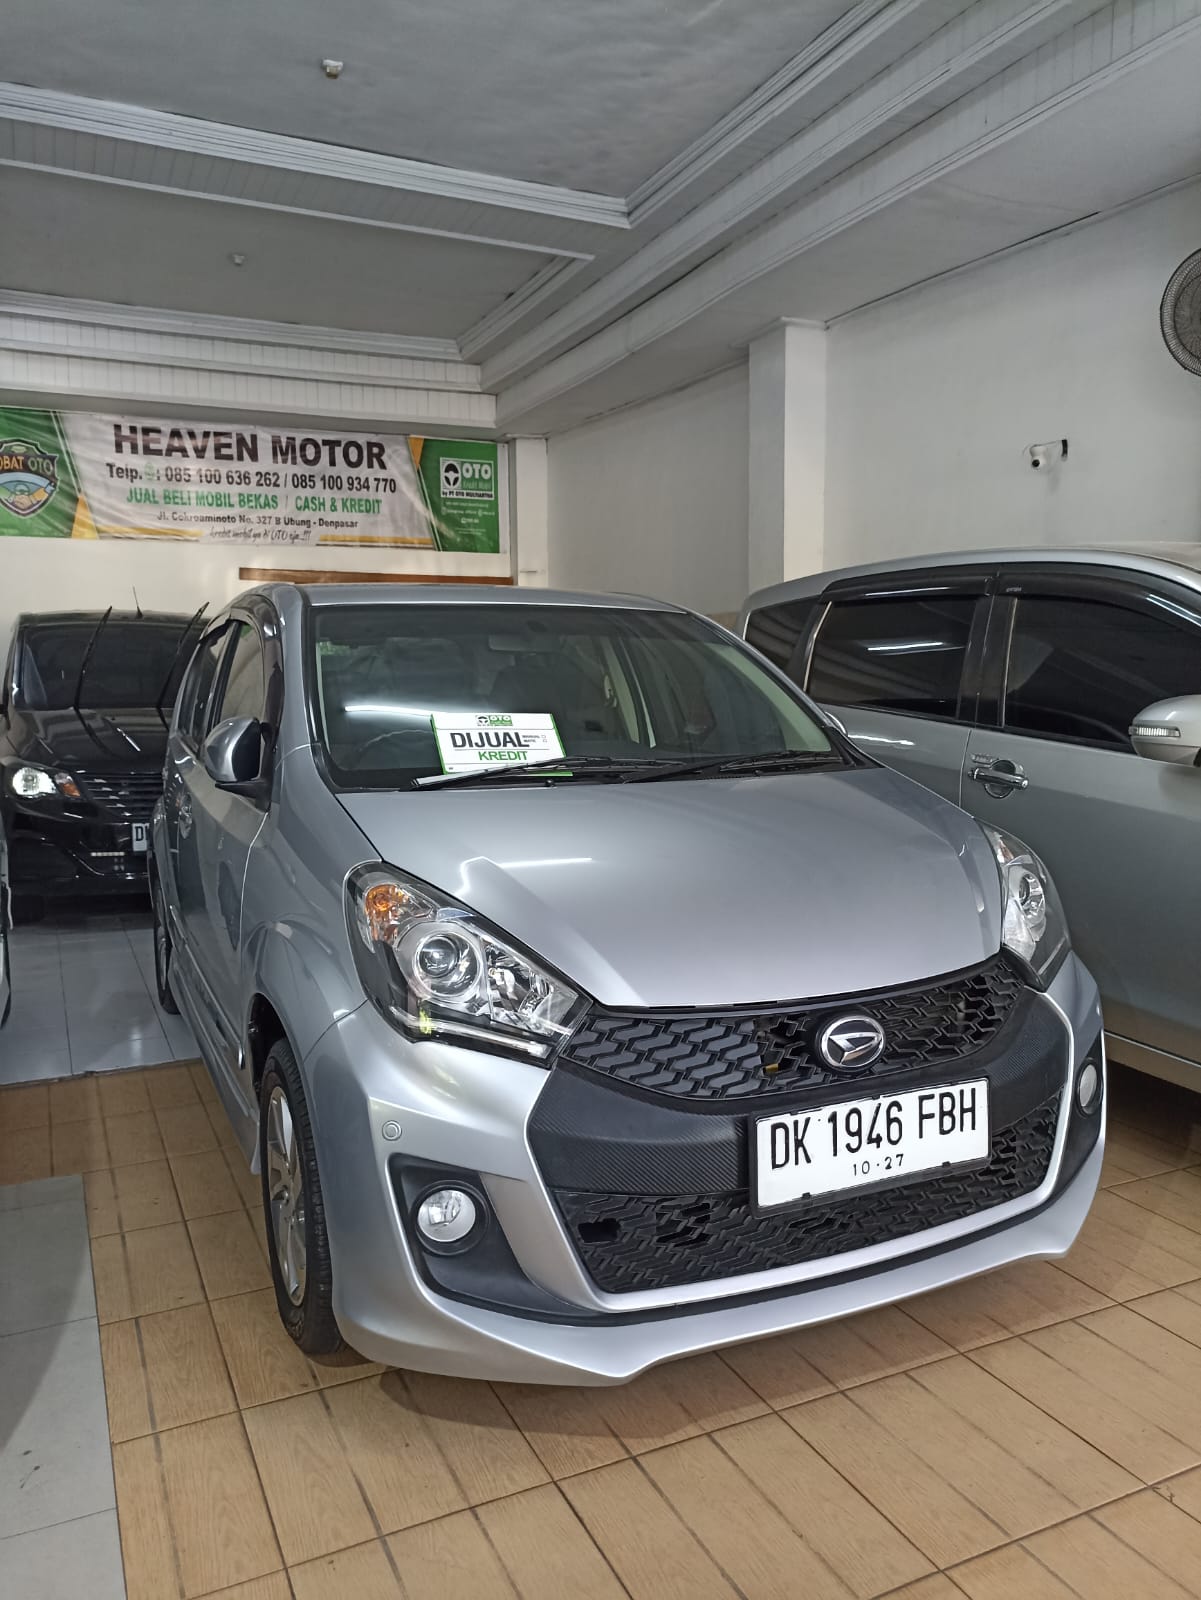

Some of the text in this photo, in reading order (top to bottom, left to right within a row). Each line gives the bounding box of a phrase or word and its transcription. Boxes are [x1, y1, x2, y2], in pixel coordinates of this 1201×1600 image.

[113, 424, 387, 470] HEAVEN MOTOR
[27, 457, 54, 476] OTO
[462, 463, 492, 480] OTO
[165, 466, 191, 482] 085
[198, 468, 221, 484] 100
[226, 470, 251, 486] 636
[255, 471, 280, 487] 262
[292, 473, 316, 489] 085
[320, 475, 343, 491] 100
[347, 476, 370, 492] 934
[373, 477, 397, 493] 770
[127, 487, 159, 505] JUAL
[163, 489, 191, 506] BELI
[195, 490, 235, 508] MOBIL
[238, 493, 278, 510] BEKAS
[295, 495, 326, 512] CASH
[329, 496, 338, 512] &
[341, 497, 382, 514] KREDIT
[157, 511, 169, 521] Jl.
[239, 514, 254, 524] No.
[256, 515, 272, 525] 327
[275, 516, 281, 526] B
[283, 516, 311, 529] Ubung
[318, 518, 358, 529] Denpasar
[450, 731, 530, 748] DIJUAL
[478, 750, 528, 761] KREDIT
[770, 1087, 976, 1170] DK 1946 FBH
